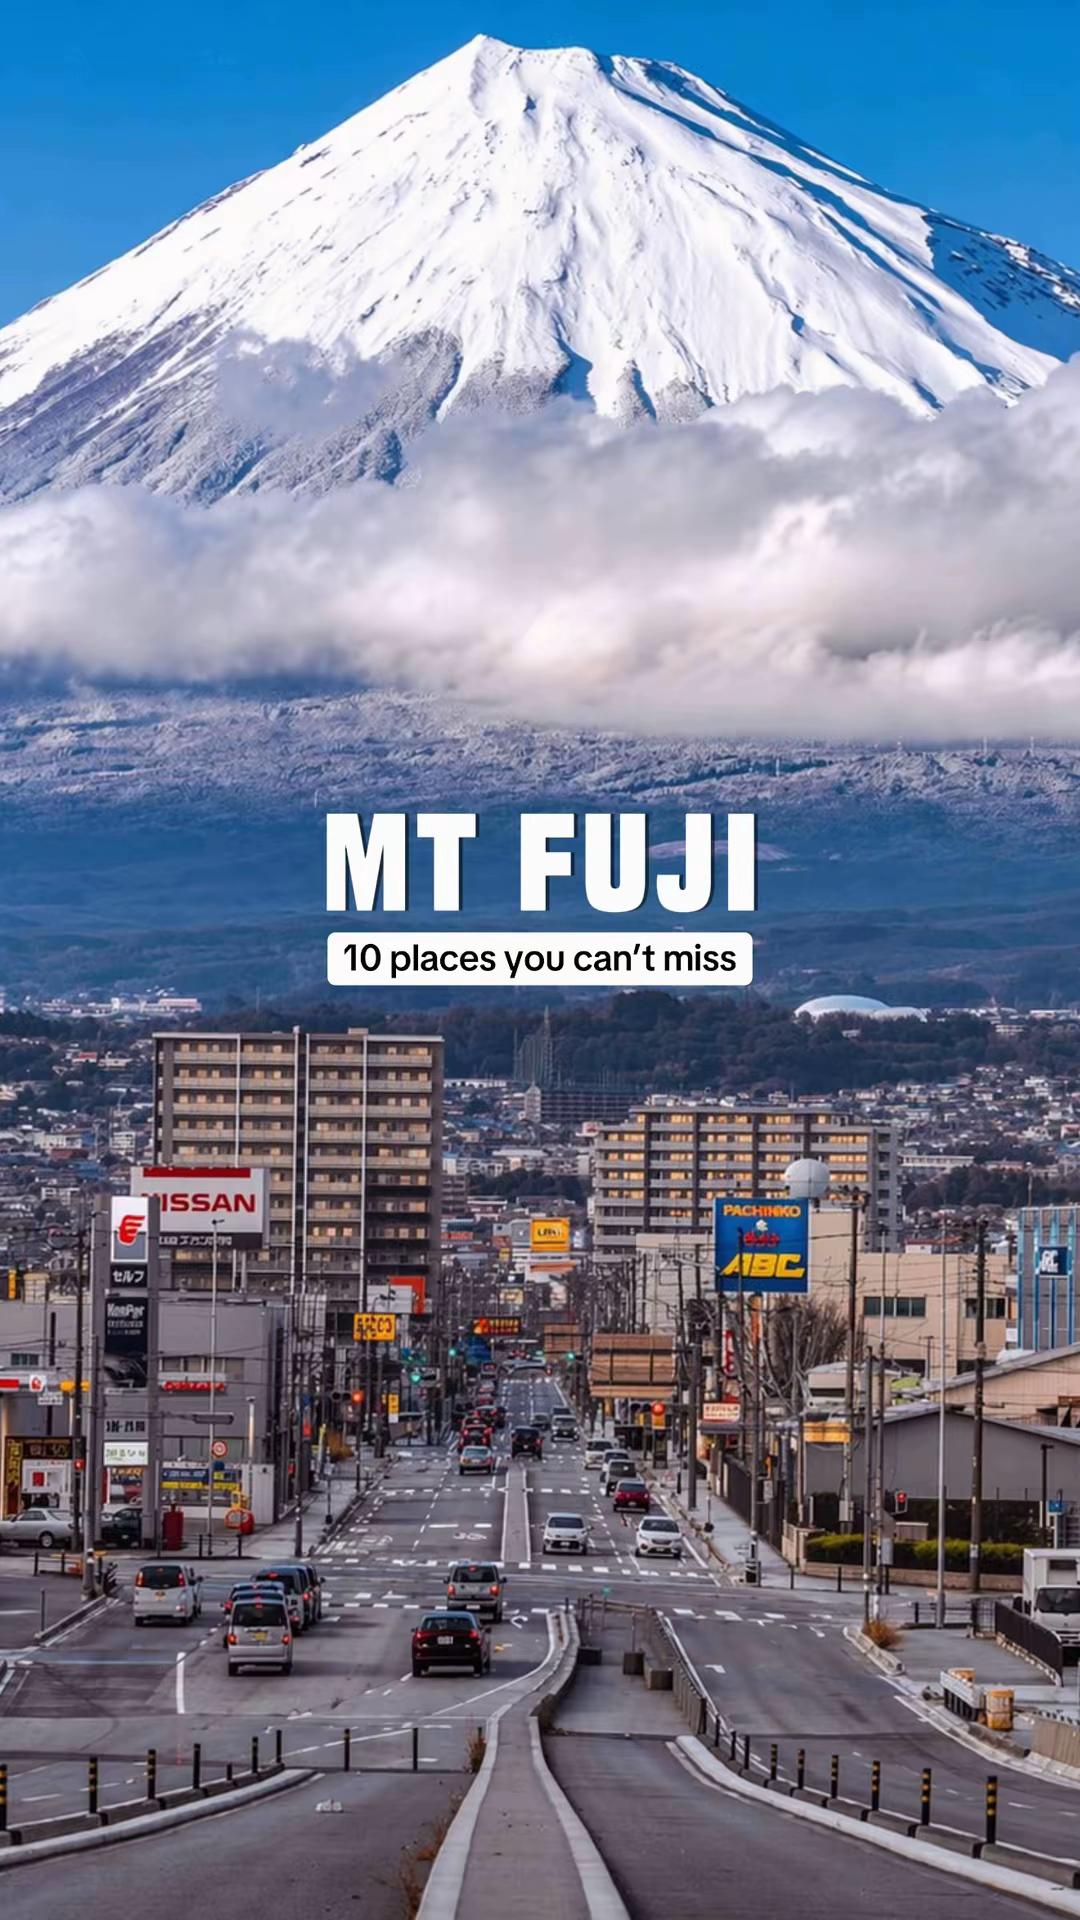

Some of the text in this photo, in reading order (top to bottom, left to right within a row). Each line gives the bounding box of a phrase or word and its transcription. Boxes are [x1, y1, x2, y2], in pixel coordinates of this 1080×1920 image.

[141, 1193, 256, 1212] ISSAN
[723, 1204, 801, 1217] PACHINKO
[721, 1253, 805, 1278] ABC
[113, 1270, 144, 1283] セルフ
